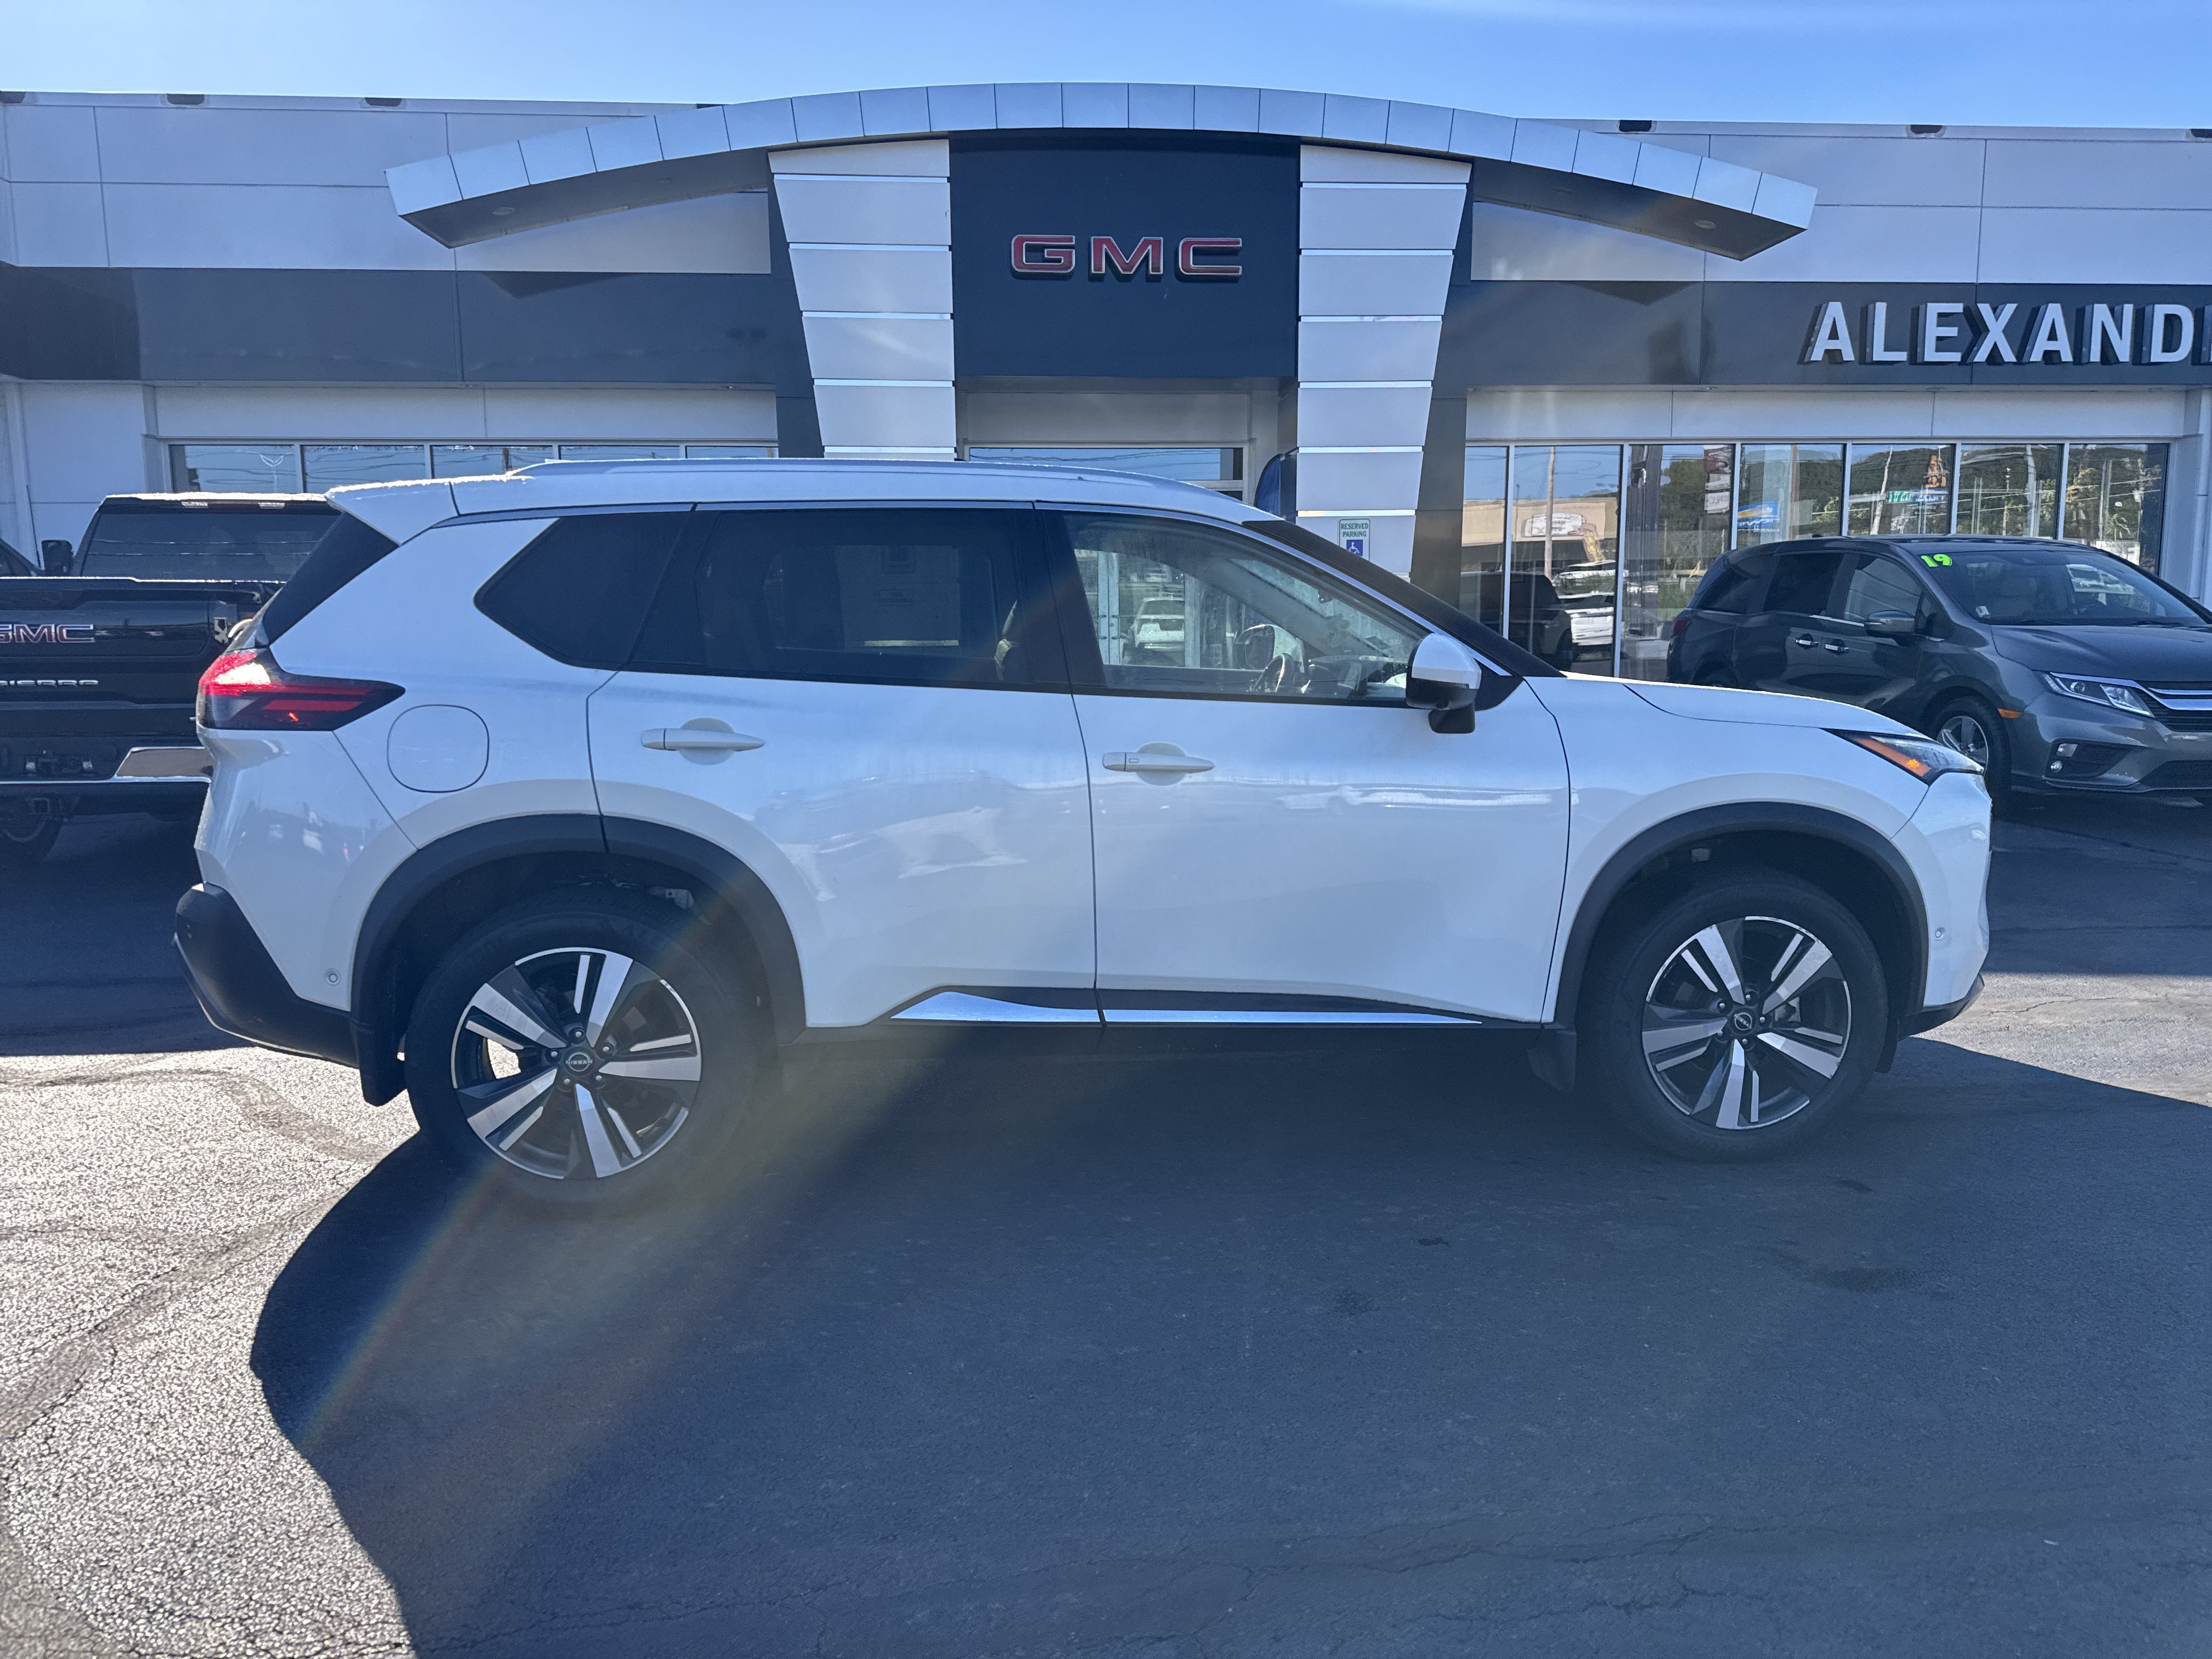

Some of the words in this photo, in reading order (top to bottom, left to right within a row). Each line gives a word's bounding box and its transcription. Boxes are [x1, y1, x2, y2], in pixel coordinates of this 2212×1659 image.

[1012, 234, 1242, 275] GMC
[1806, 301, 2212, 364] ALEXAND
[1921, 554, 1953, 567] 19
